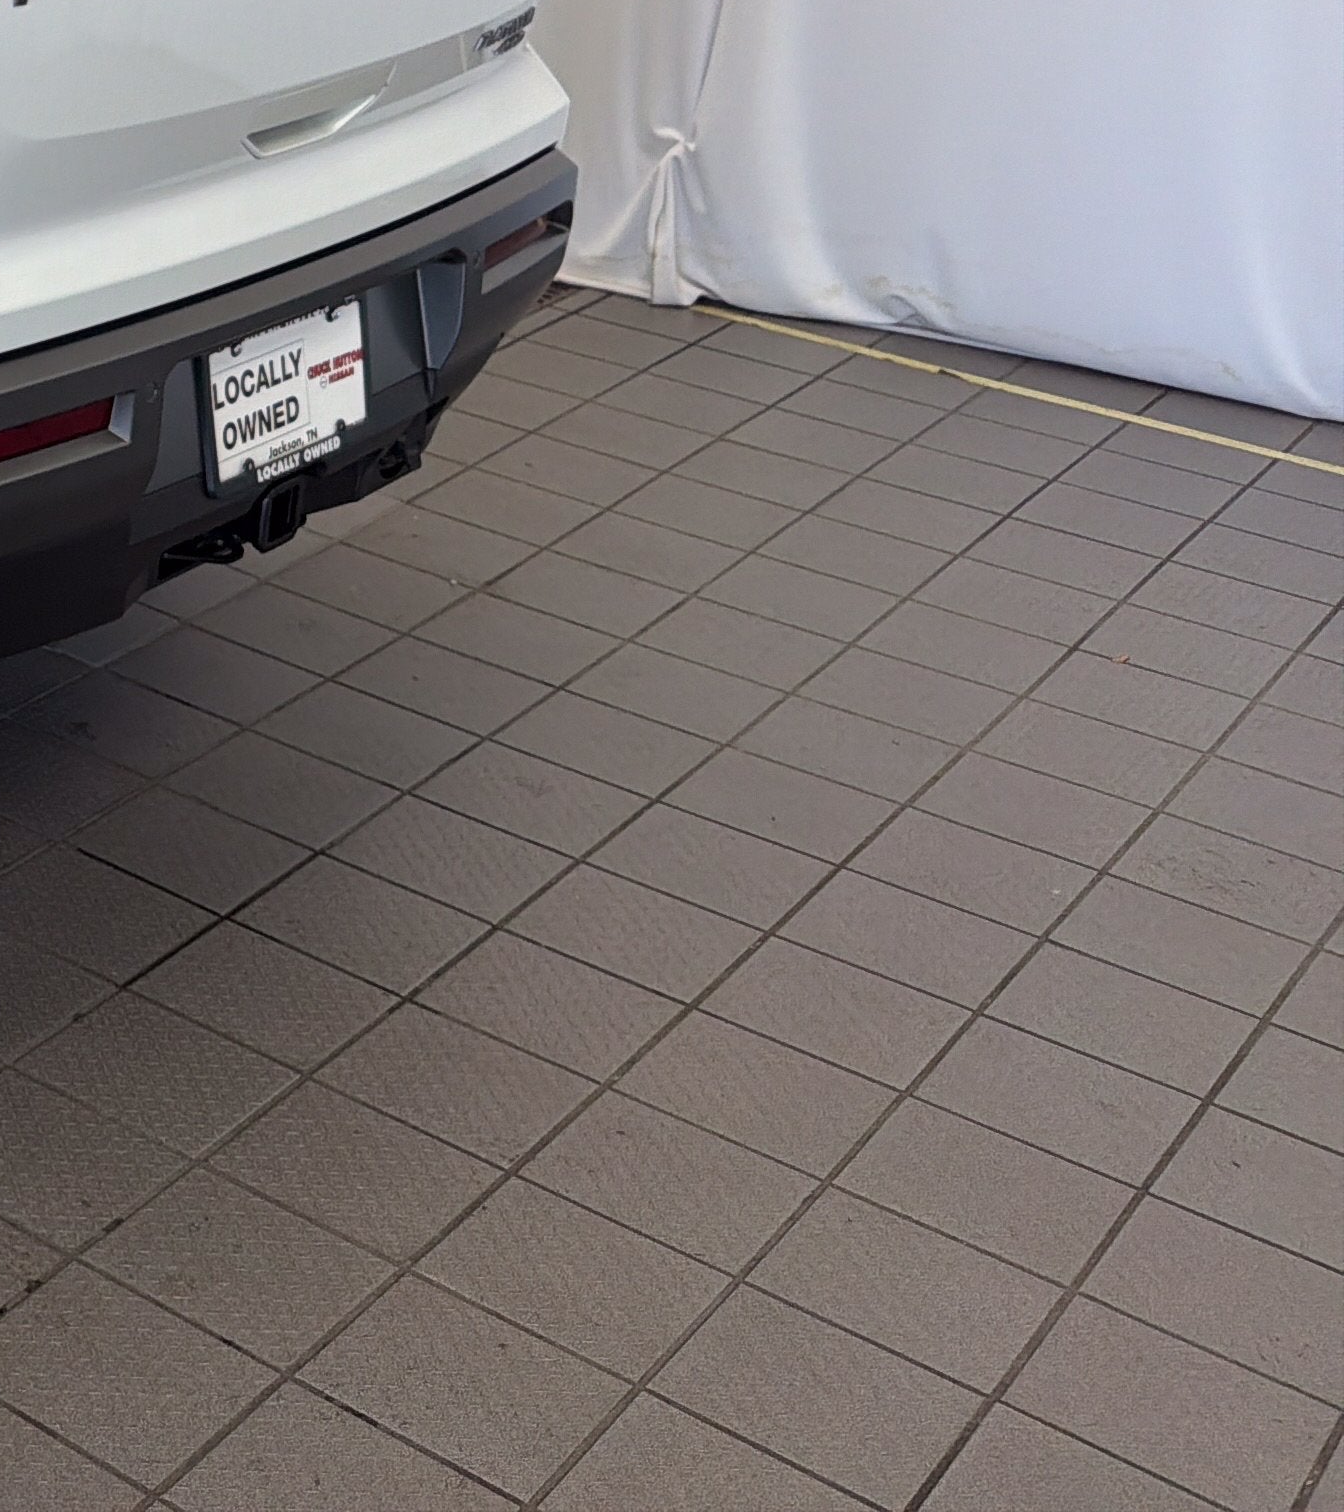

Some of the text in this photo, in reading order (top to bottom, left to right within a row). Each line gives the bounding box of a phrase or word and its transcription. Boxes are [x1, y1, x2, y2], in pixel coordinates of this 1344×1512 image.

[213, 347, 302, 411] LOCALLY
[222, 395, 300, 450] OWNED
[268, 427, 318, 459] Jackson, TN
[256, 435, 341, 484] LOCALLY OWNED
